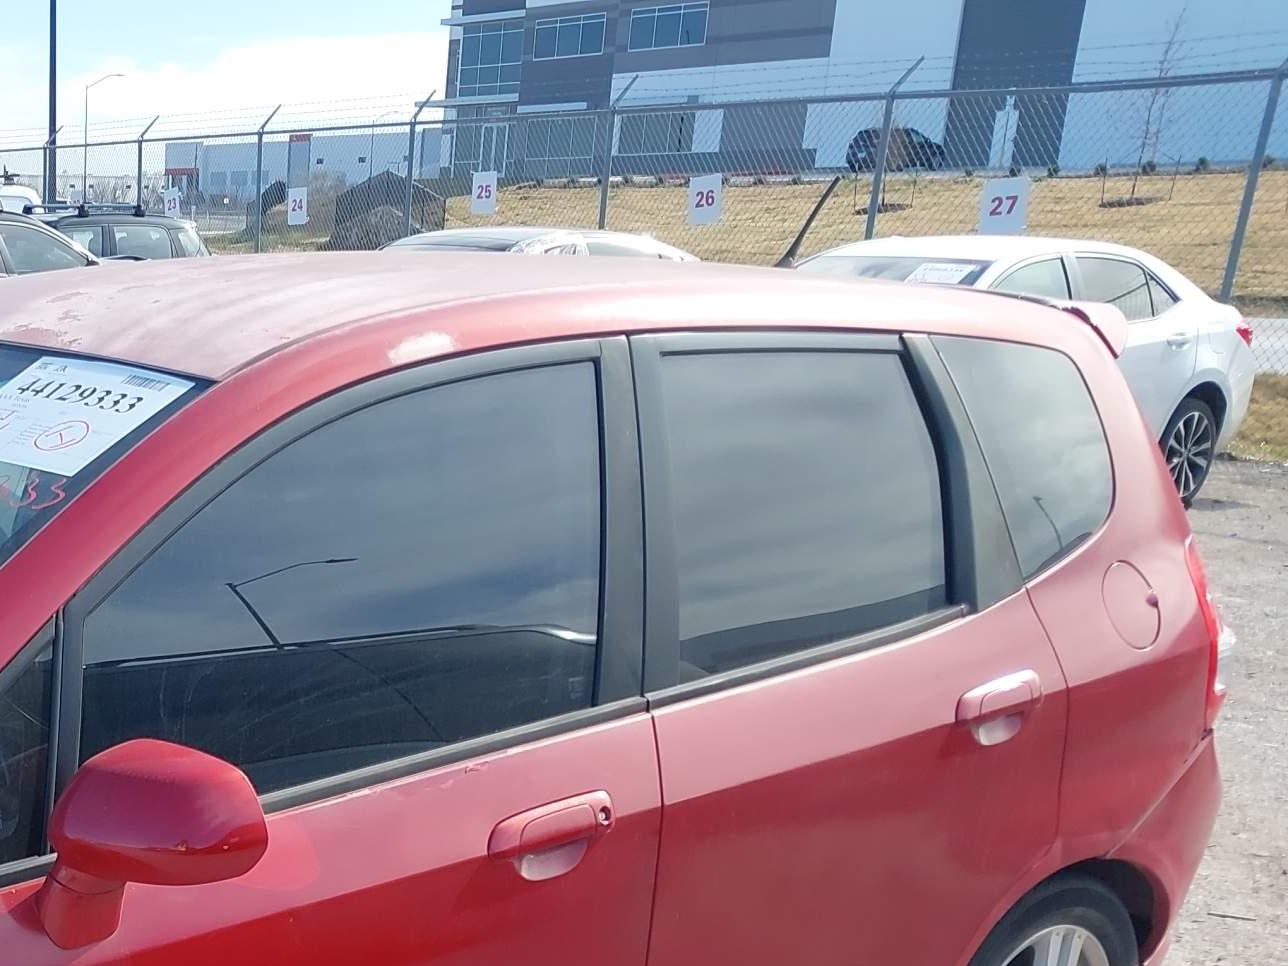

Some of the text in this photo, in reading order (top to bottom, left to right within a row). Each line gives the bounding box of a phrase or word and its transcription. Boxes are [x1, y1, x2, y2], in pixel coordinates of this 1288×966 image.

[476, 184, 492, 200] 25
[694, 190, 716, 208] 26
[166, 200, 178, 212] 23
[290, 198, 304, 212] 24
[988, 195, 1019, 216] 27
[15, 377, 145, 414] 44129333
